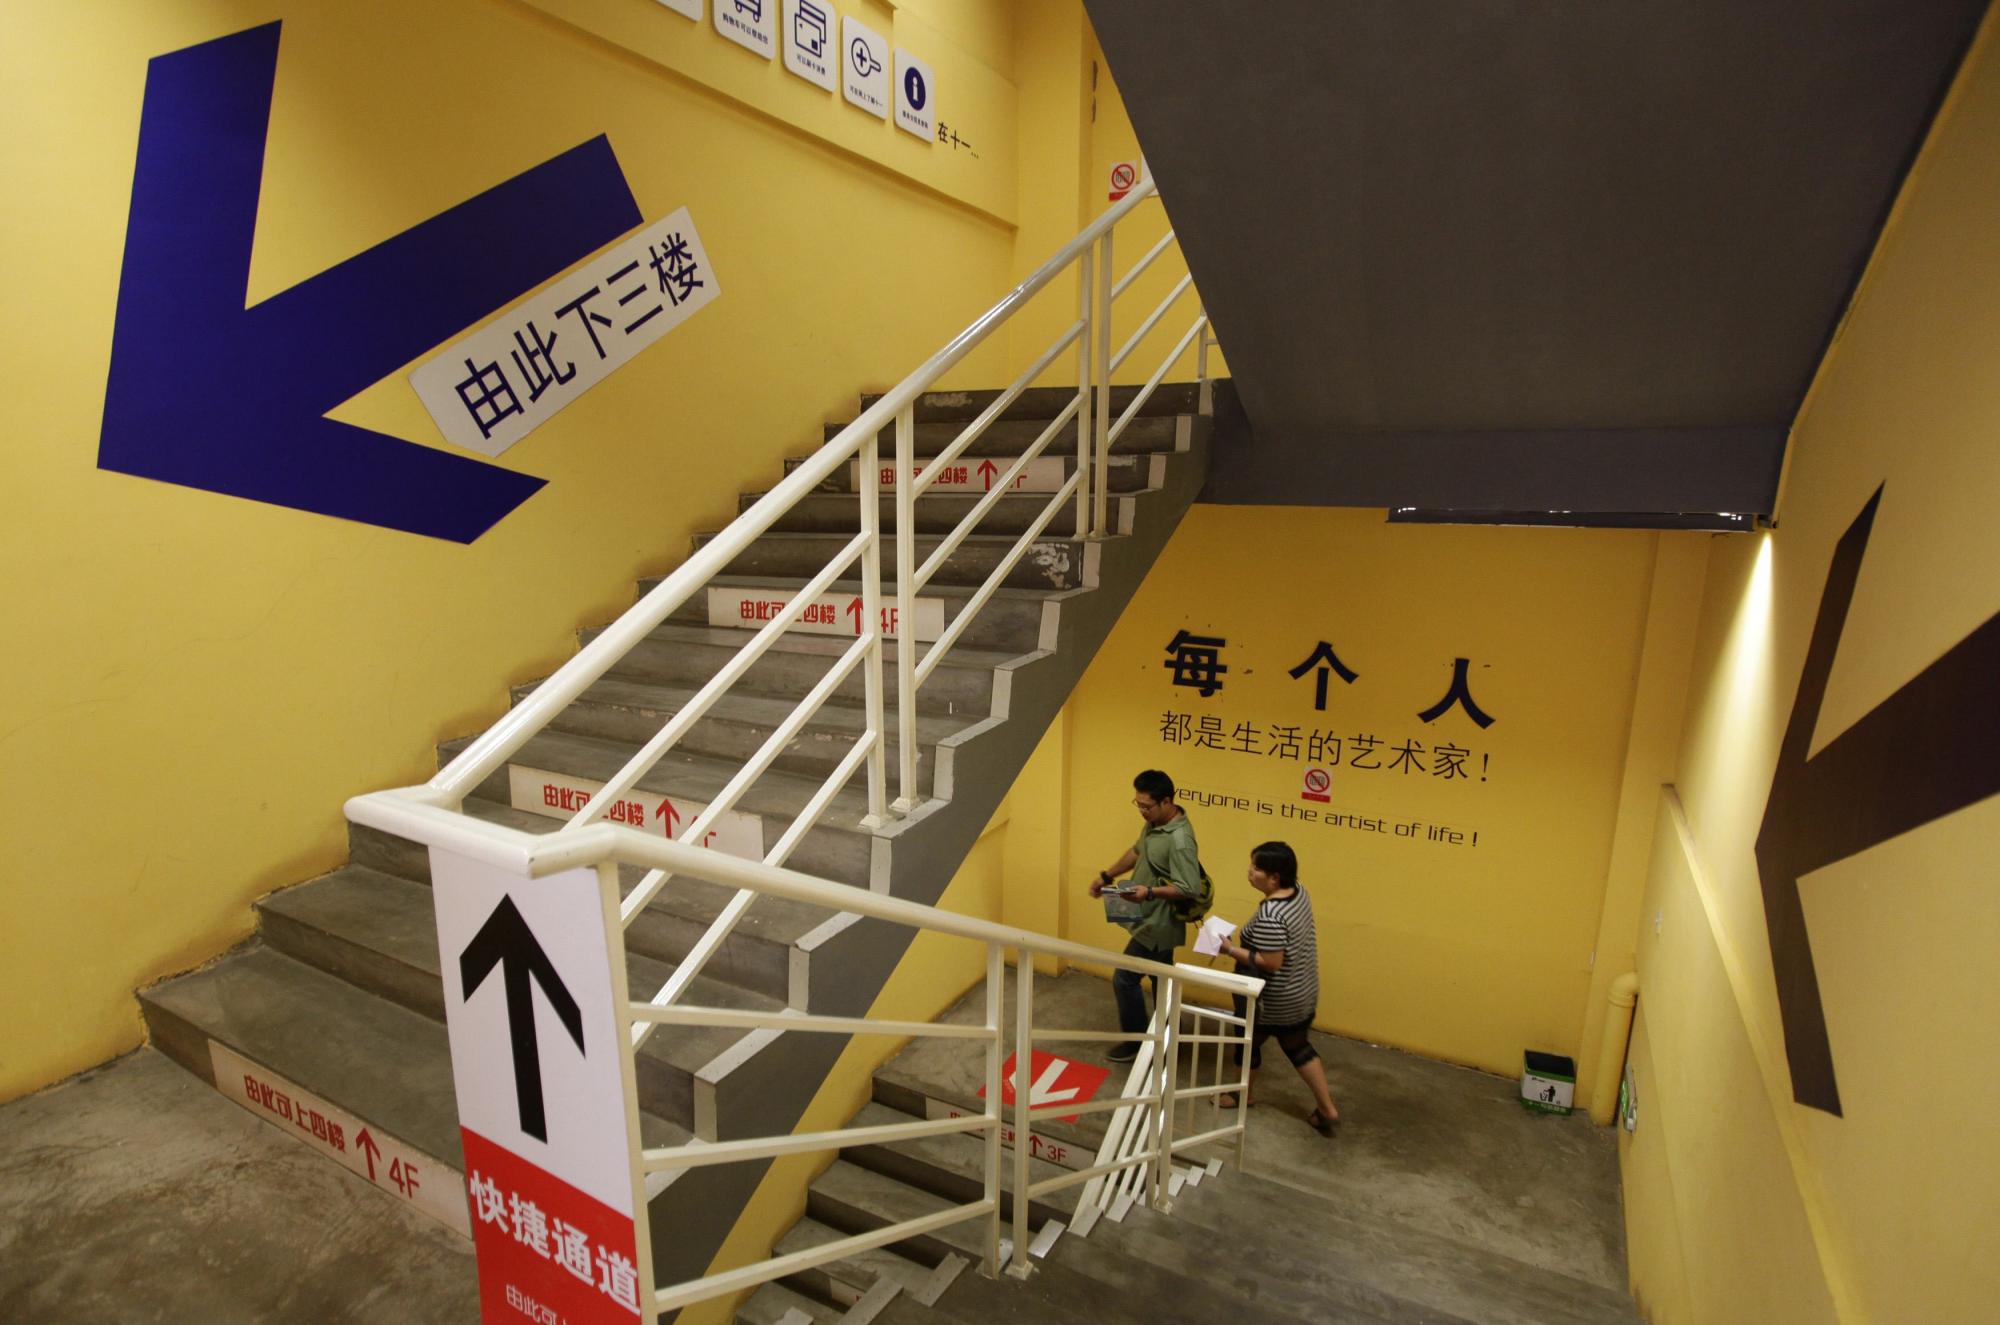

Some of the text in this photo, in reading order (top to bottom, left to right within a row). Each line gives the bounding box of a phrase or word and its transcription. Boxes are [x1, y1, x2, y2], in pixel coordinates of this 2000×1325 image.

[454, 231, 704, 440] 由此下三楼
[740, 599, 836, 625] 由此可四楼
[543, 784, 645, 828] 由此可四楼
[1257, 799, 1273, 816] is
[1281, 803, 1318, 823] the
[1325, 812, 1388, 834] artist
[1395, 822, 1422, 838] of
[244, 1074, 346, 1153] 由此可上四楼
[1047, 1144, 1067, 1162] 3F
[389, 1157, 420, 1199] 4F
[470, 1169, 641, 1317] 快捷通道
